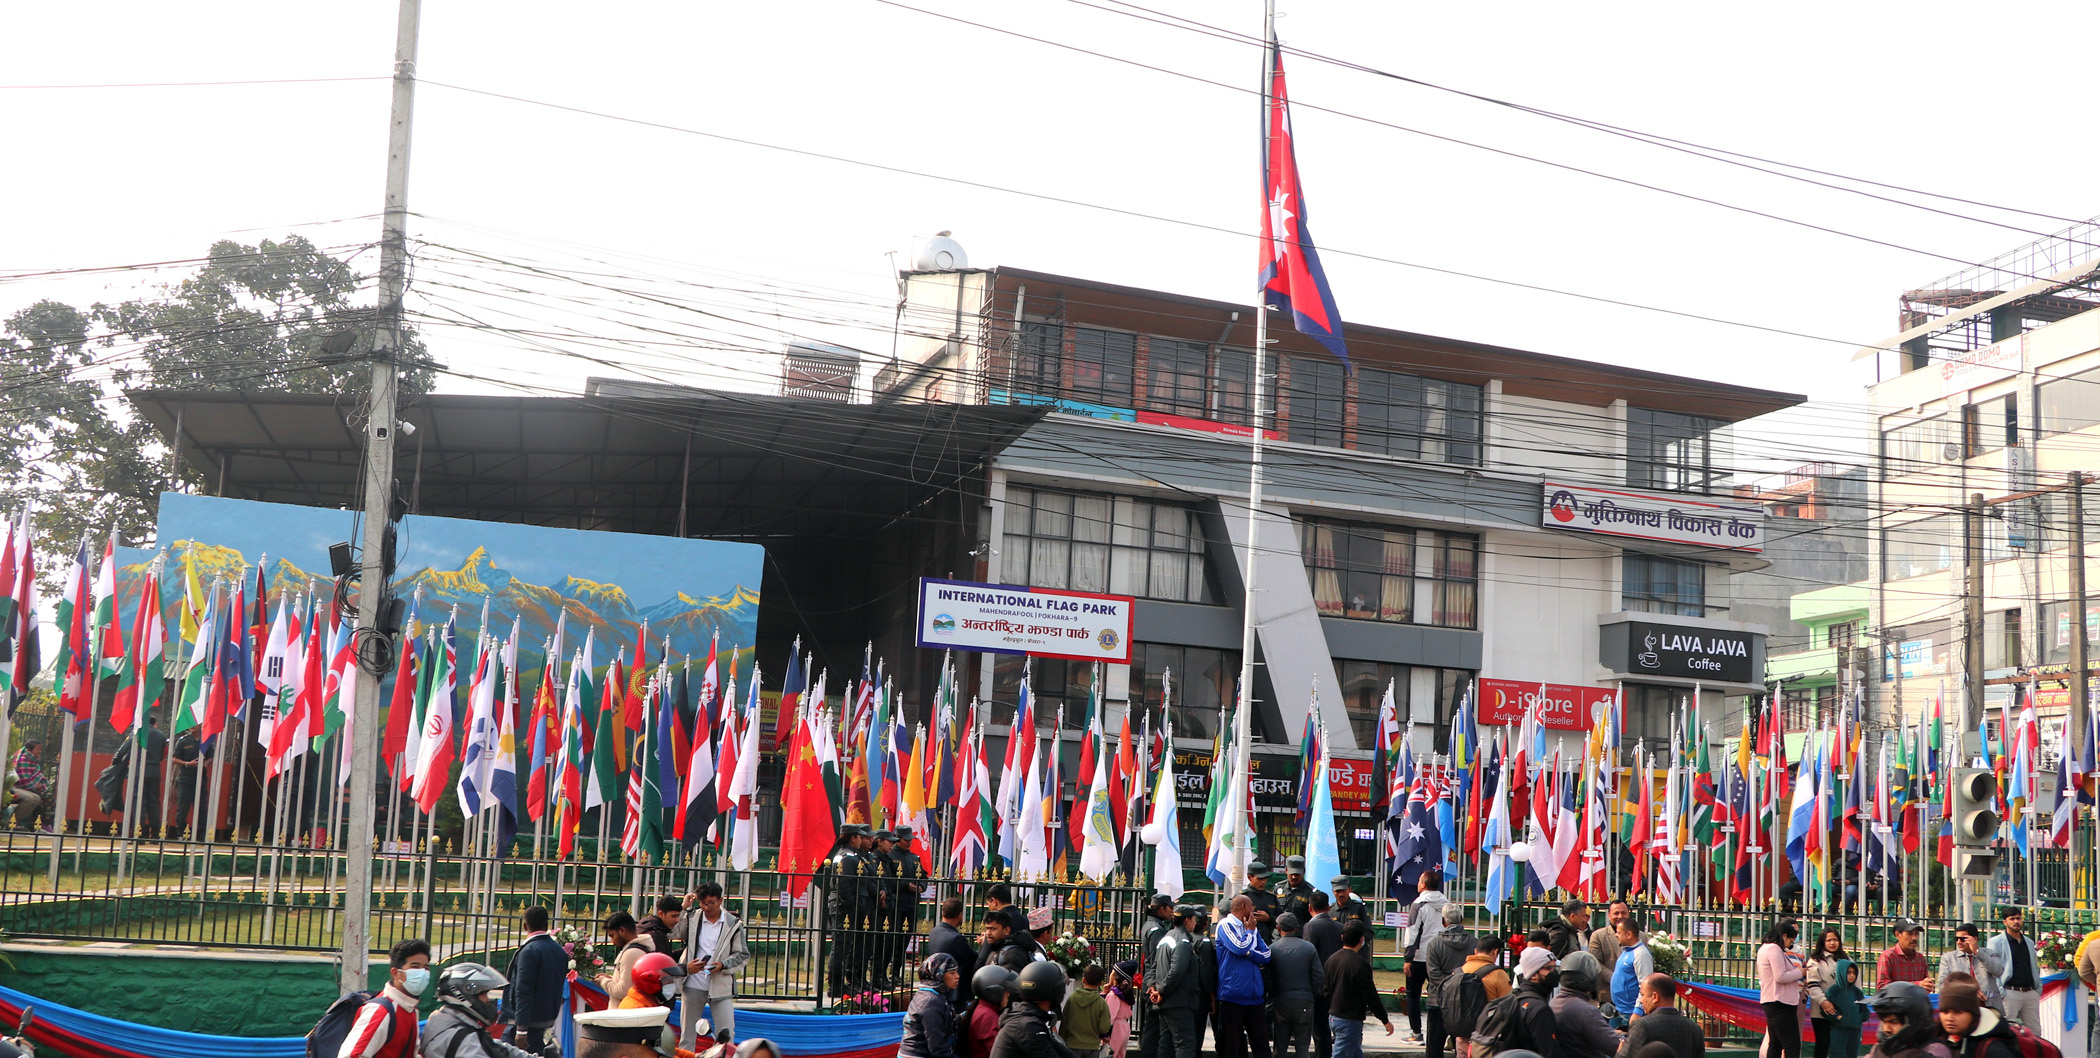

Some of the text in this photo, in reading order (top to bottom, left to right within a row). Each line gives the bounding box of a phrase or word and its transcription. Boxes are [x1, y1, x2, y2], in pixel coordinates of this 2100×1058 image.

[1955, 345, 2000, 369] DOMO DOMO
[1583, 499, 1662, 529] मुक्तिनाथ
[1668, 508, 1723, 536] विकास
[938, 589, 1117, 616] INTERNATIONAL FLAG PARK
[1028, 624, 1062, 637] झण्डा
[1066, 627, 1091, 640] पार्क
[1661, 633, 1747, 657] LAVA JAVA
[1687, 657, 1722, 671] Coffee
[1495, 689, 1573, 714] D-iSore
[1493, 711, 1524, 722] Authori
